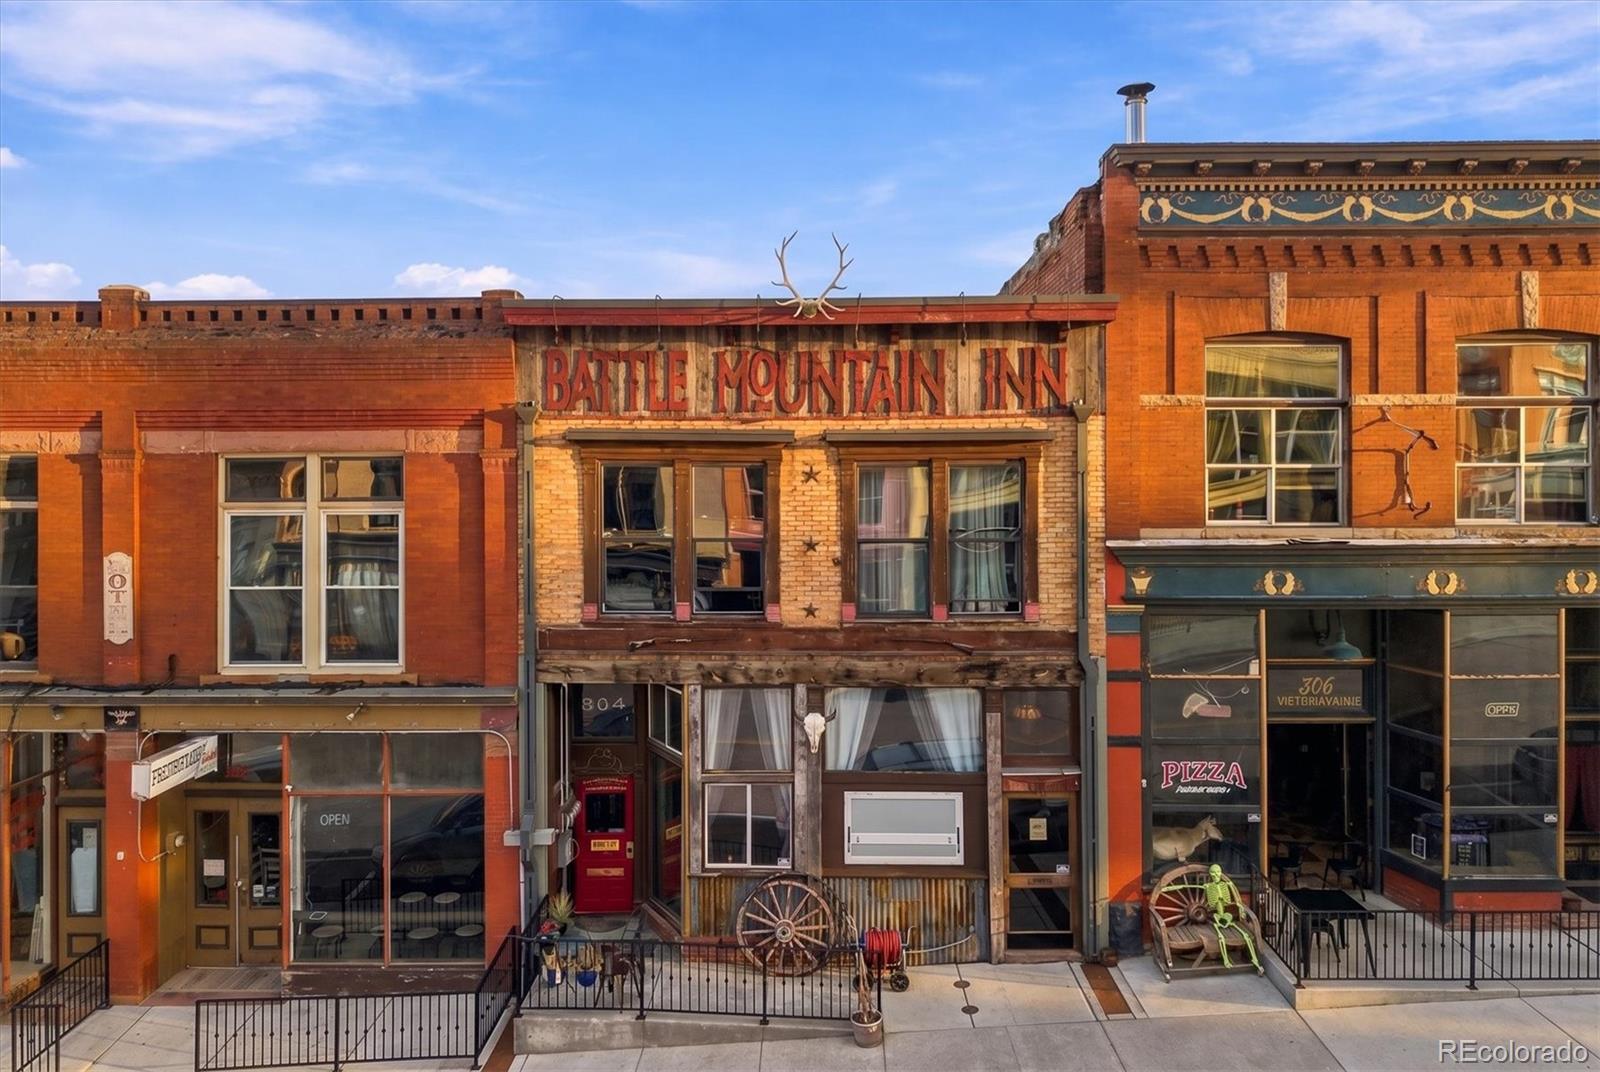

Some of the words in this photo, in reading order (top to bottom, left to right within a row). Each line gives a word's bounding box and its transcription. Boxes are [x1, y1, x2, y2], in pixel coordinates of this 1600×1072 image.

[542, 350, 688, 412] BATTLE
[715, 350, 945, 415] MOUNTAIN
[981, 347, 1067, 411] INN
[1298, 676, 1335, 695] 306
[1161, 761, 1247, 789] PIZZA
[320, 813, 351, 826] OPEN
